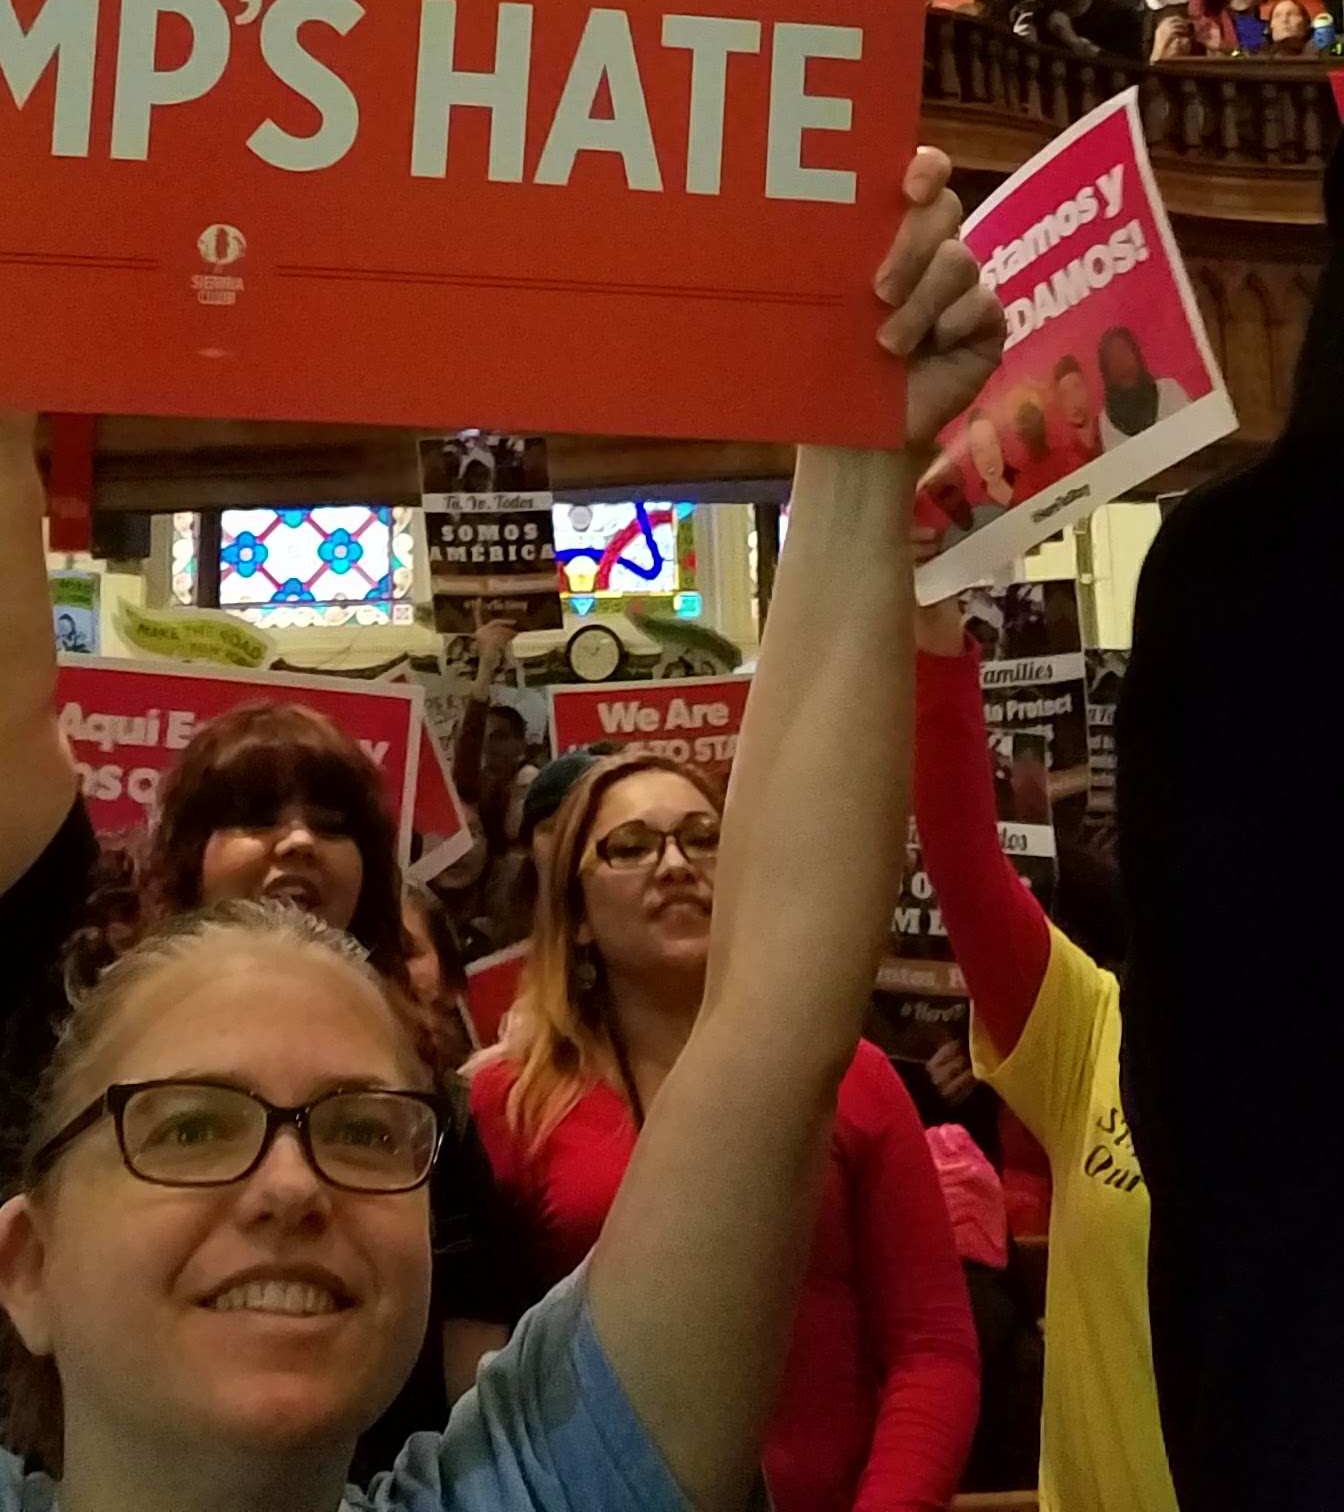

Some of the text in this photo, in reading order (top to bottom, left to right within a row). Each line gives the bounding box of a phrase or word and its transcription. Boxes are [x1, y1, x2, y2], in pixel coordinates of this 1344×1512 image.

[978, 184, 1099, 290] stamos
[440, 522, 539, 543] SOMOS
[596, 698, 730, 734] We Are
[1007, 693, 1074, 722] Protect
